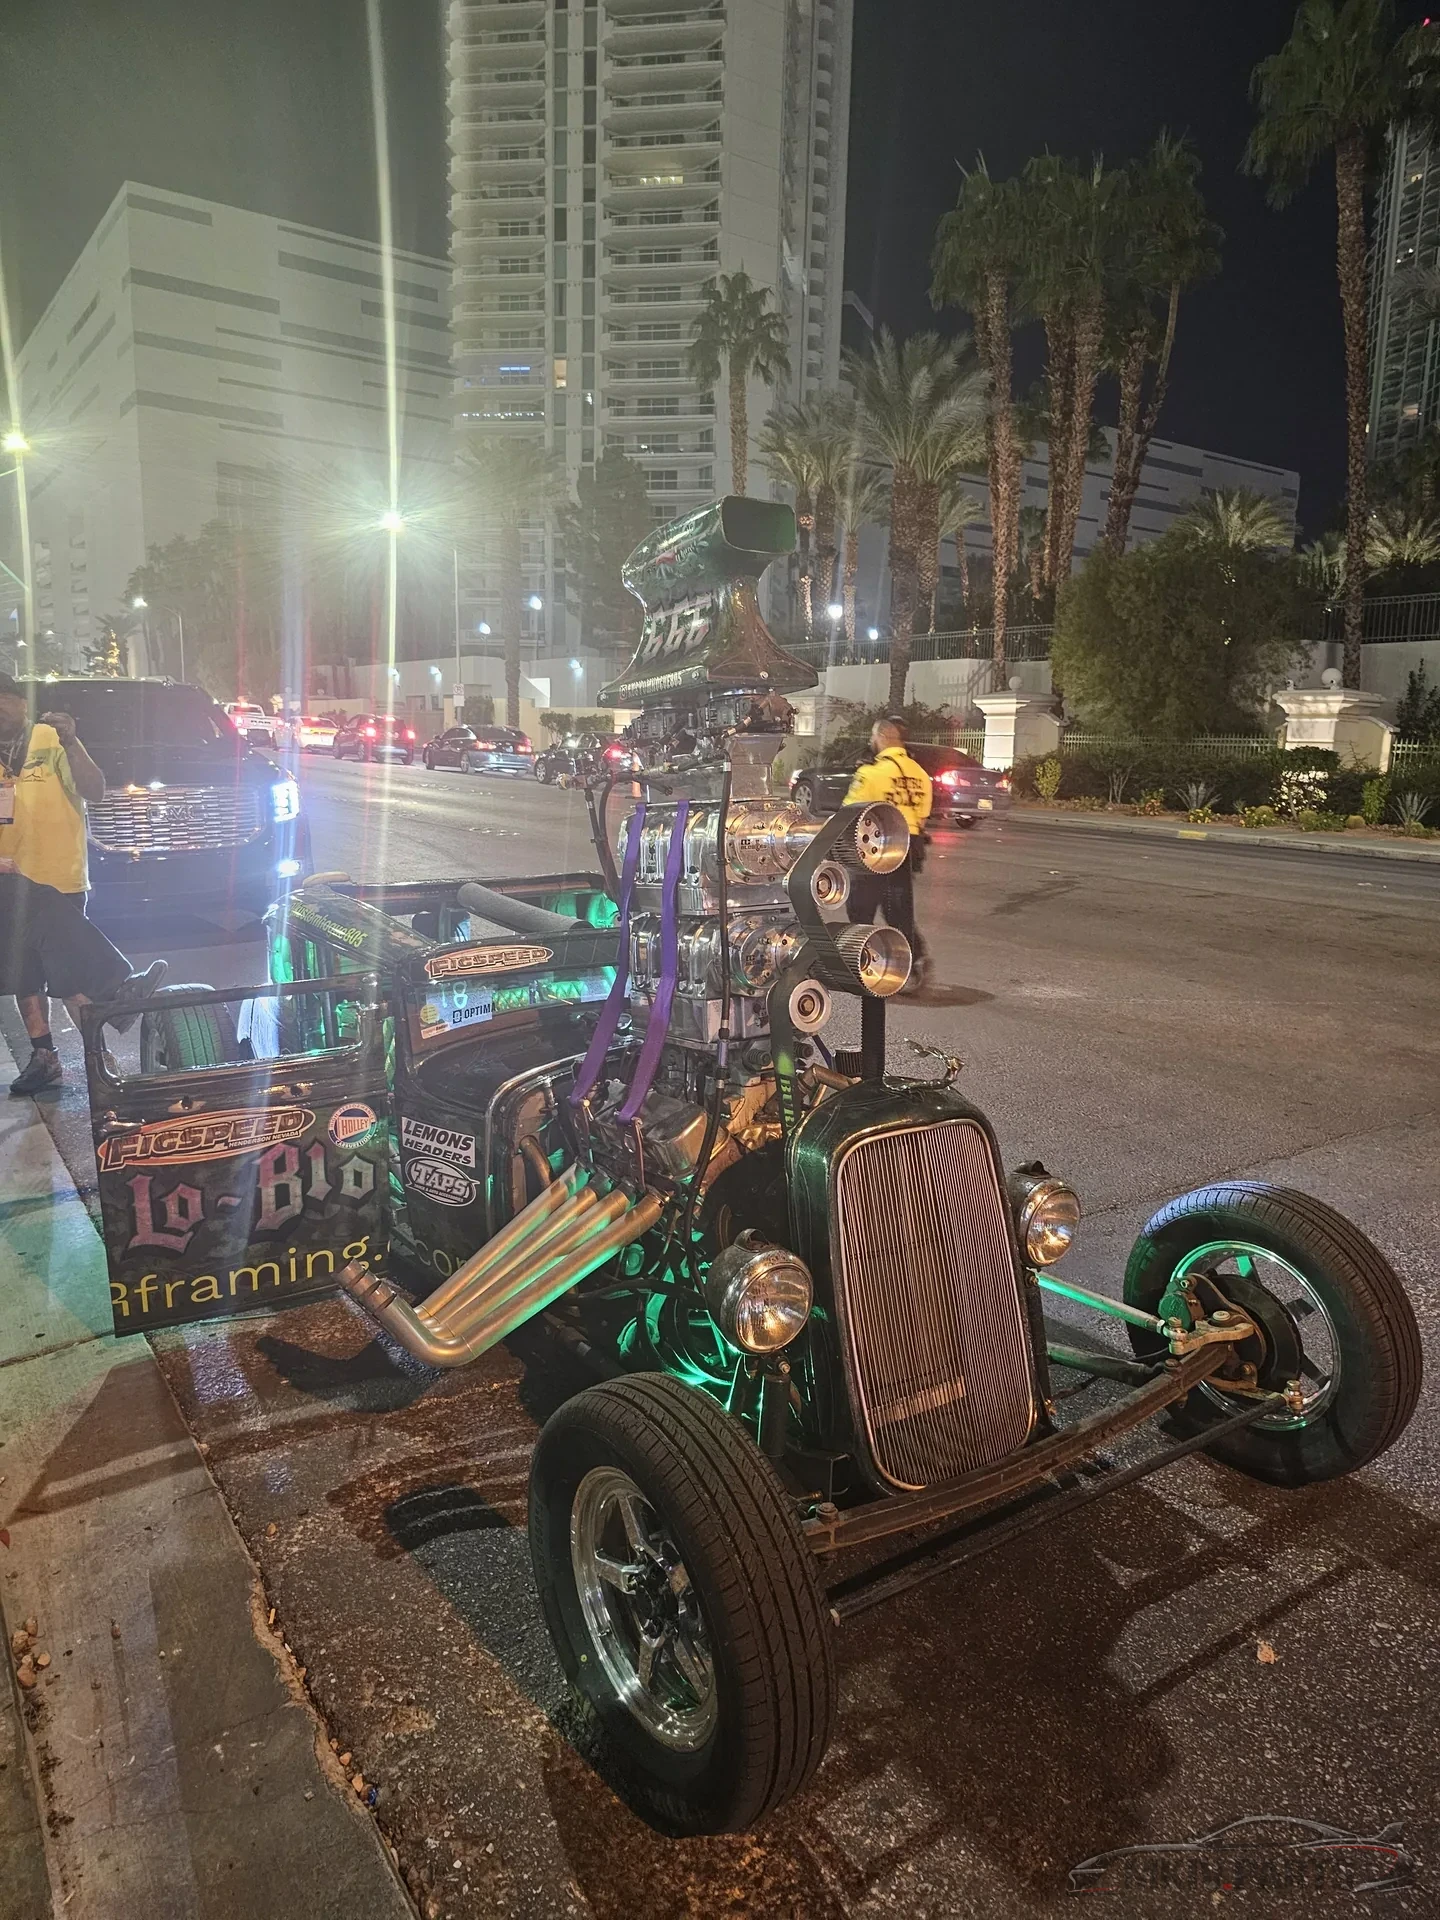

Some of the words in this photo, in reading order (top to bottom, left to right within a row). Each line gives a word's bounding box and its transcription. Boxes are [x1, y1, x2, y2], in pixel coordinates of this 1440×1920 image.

[146, 804, 206, 823] GMC
[464, 1003, 496, 1019] OPTIMA
[228, 1135, 272, 1148] HENDERSON
[272, 1130, 300, 1142] NEVADA
[341, 1119, 369, 1136] HOLLEY
[403, 1119, 474, 1152] LEMONS
[404, 1137, 472, 1165] HEADERS
[414, 1161, 469, 1197] TAPS
[126, 1141, 377, 1254] Lo-Blo
